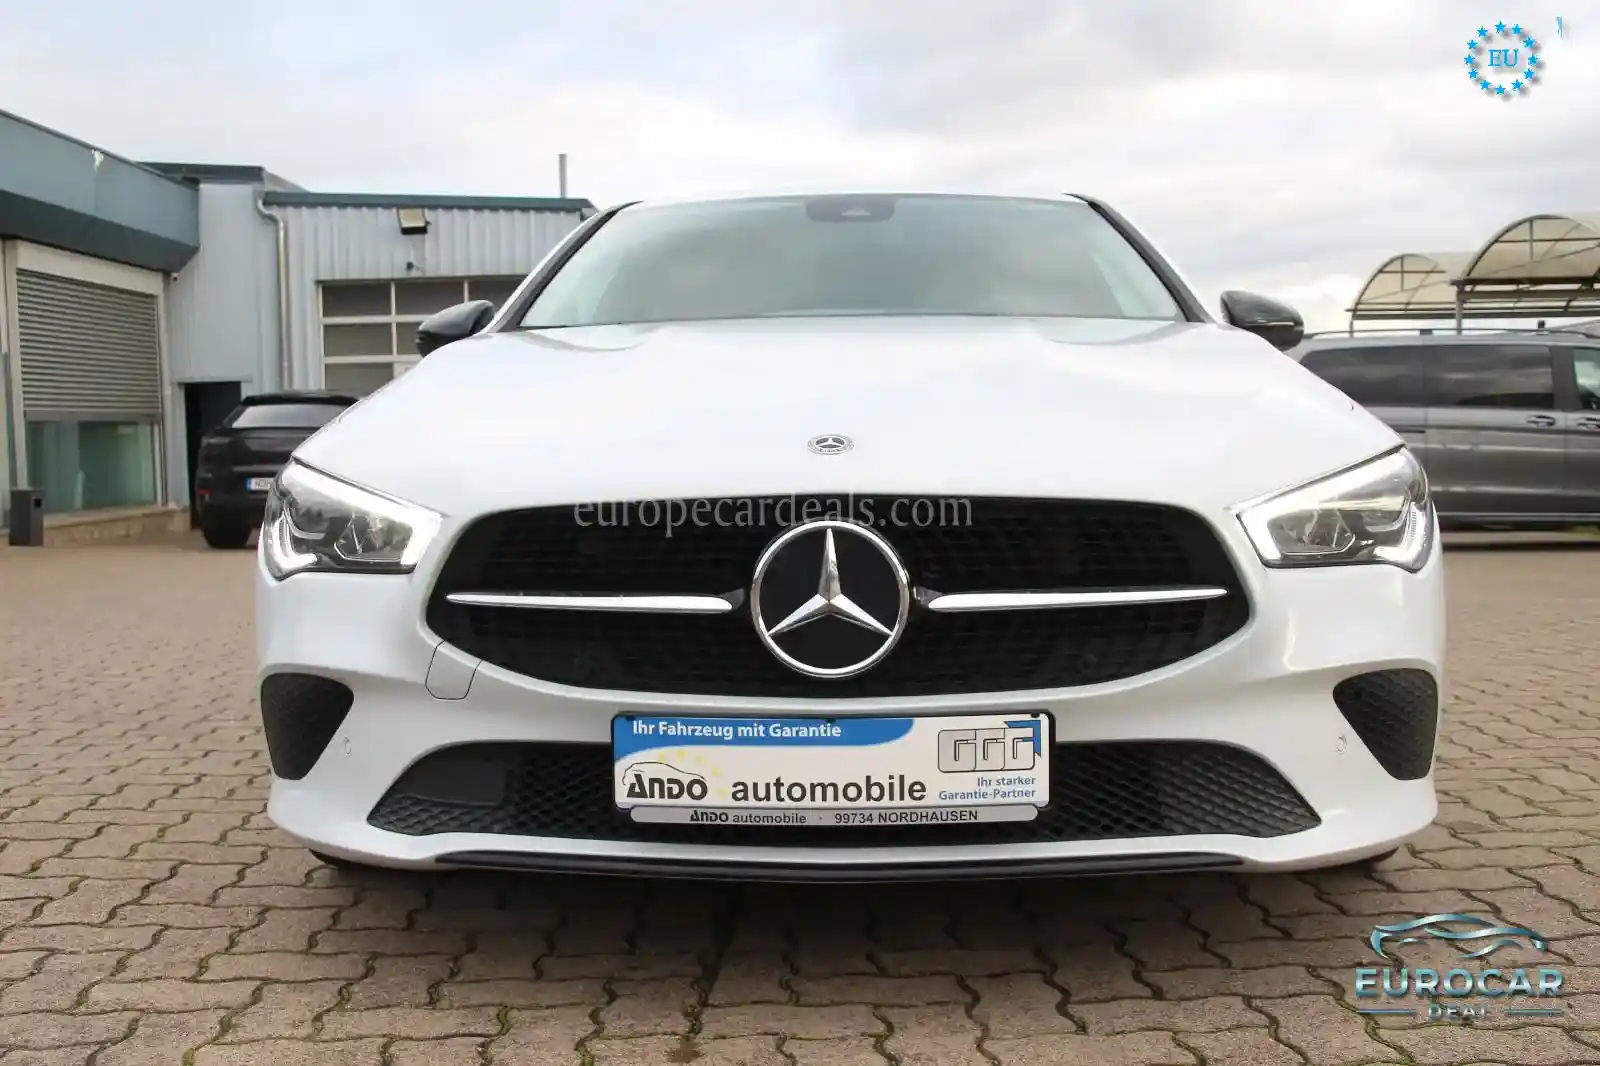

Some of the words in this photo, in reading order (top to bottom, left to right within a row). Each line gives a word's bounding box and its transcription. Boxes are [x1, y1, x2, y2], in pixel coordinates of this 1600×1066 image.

[632, 720, 655, 735] Ihr
[658, 721, 734, 740] Fahrzeug
[737, 723, 766, 738] mit
[769, 723, 842, 738] Garantie
[731, 775, 927, 802] automobile
[976, 777, 993, 787] Ihr
[995, 776, 1037, 787] starker
[938, 789, 1037, 801] Garantie-Partner
[732, 812, 807, 825] automobile
[834, 812, 874, 824] 99734
[878, 810, 978, 824] NORDHAUSEN
